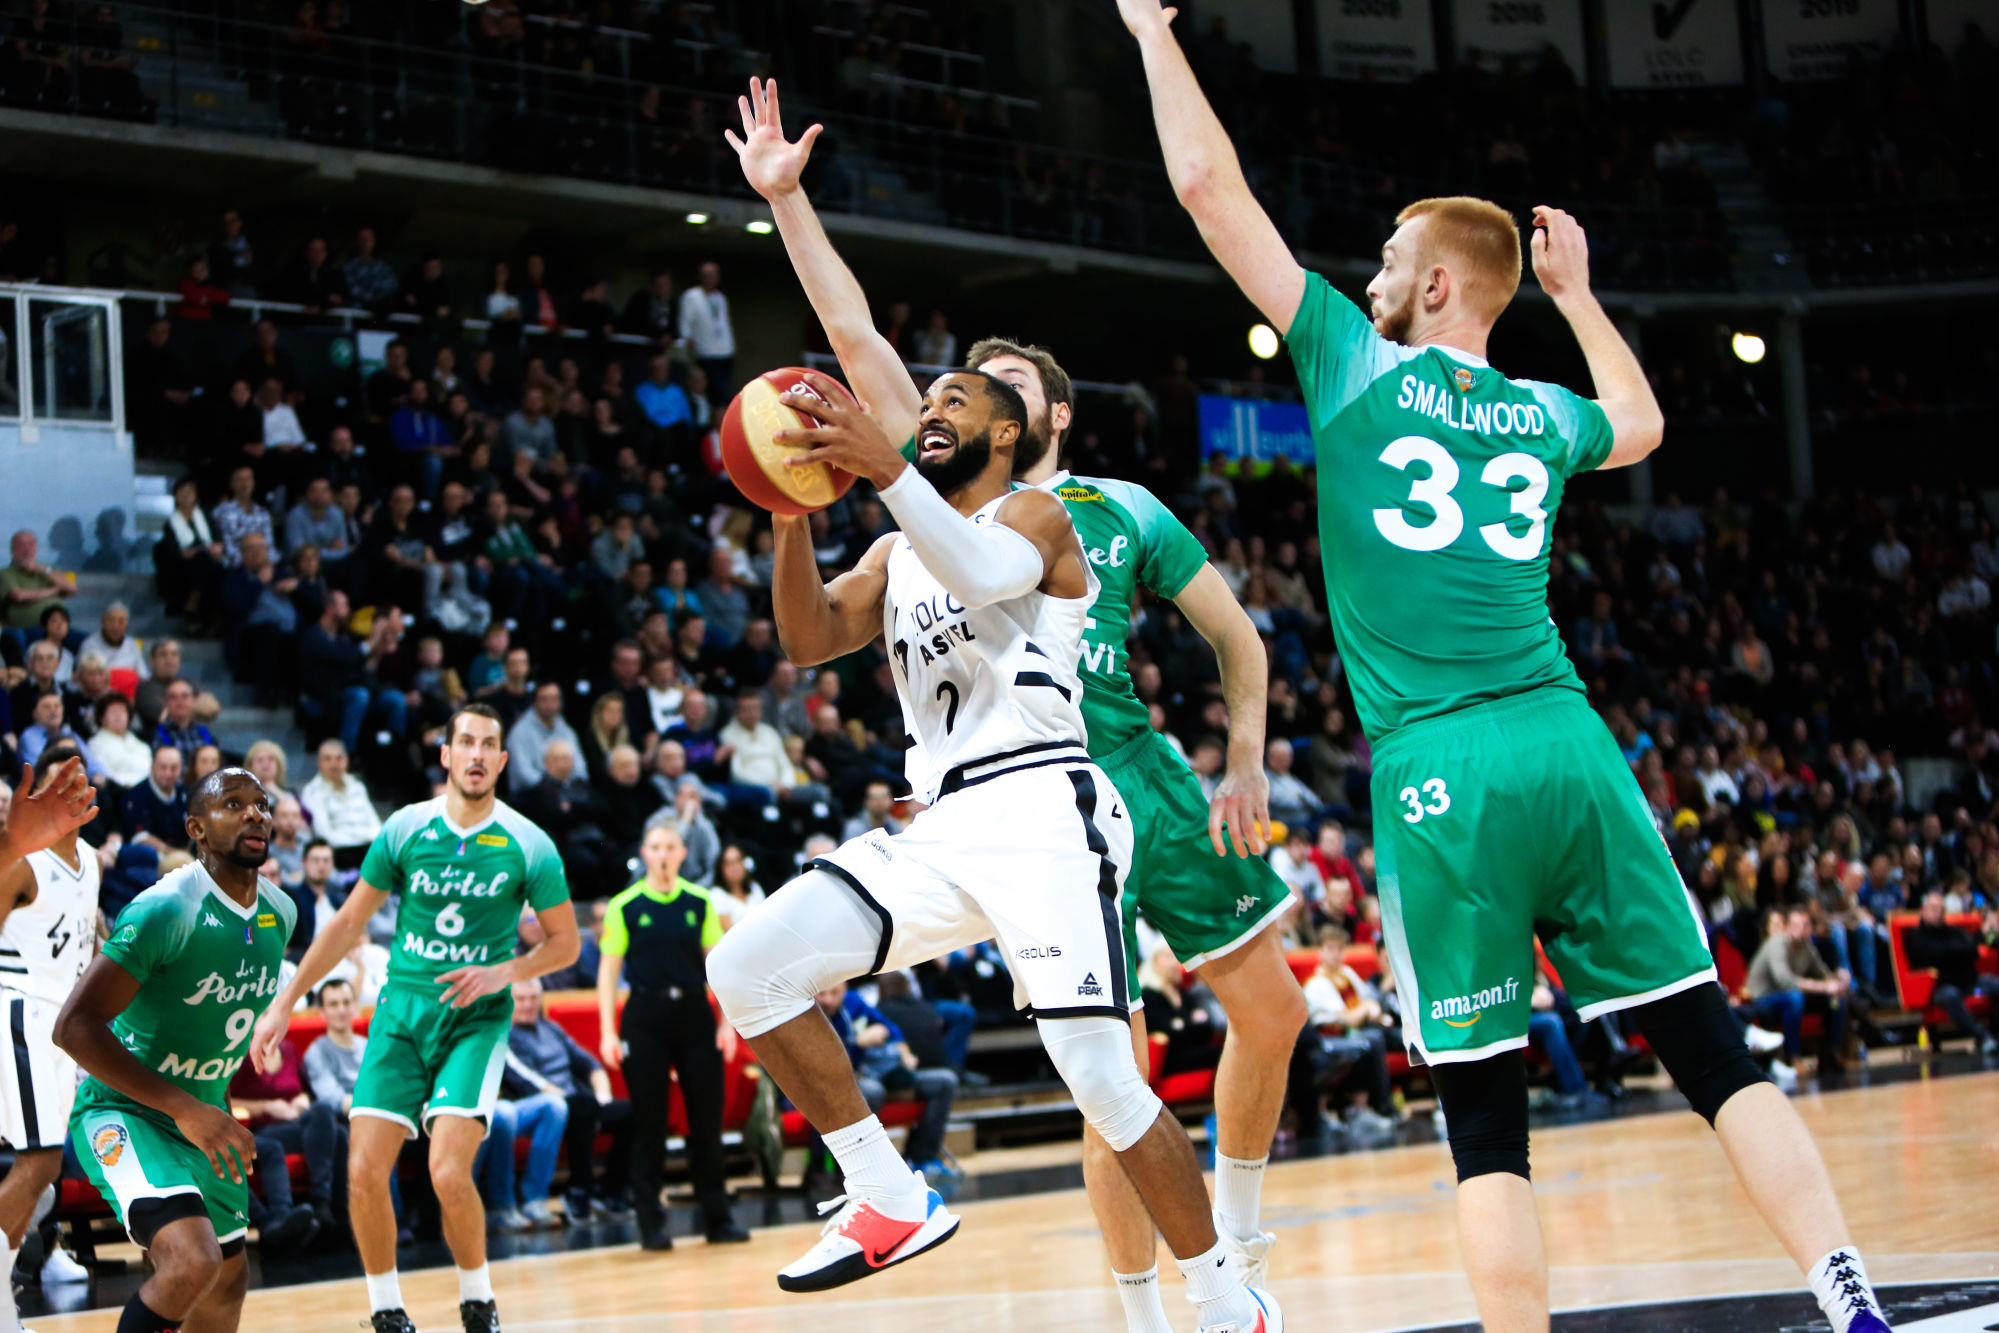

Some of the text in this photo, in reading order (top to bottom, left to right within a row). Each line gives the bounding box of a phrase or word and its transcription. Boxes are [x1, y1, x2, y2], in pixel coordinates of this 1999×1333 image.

[1397, 374, 1545, 436] SMALLWOOD
[1372, 435, 1550, 561] 33
[919, 620, 976, 667] ASVEL
[1400, 777, 1451, 824] 33
[410, 868, 510, 898] Portel
[434, 902, 466, 938] 6
[402, 931, 489, 963] MOWI
[1015, 946, 1062, 960] KEOLIS
[1077, 985, 1104, 997] PEAK
[1430, 976, 1520, 1020] amazon.fr
[222, 1007, 255, 1053] 9
